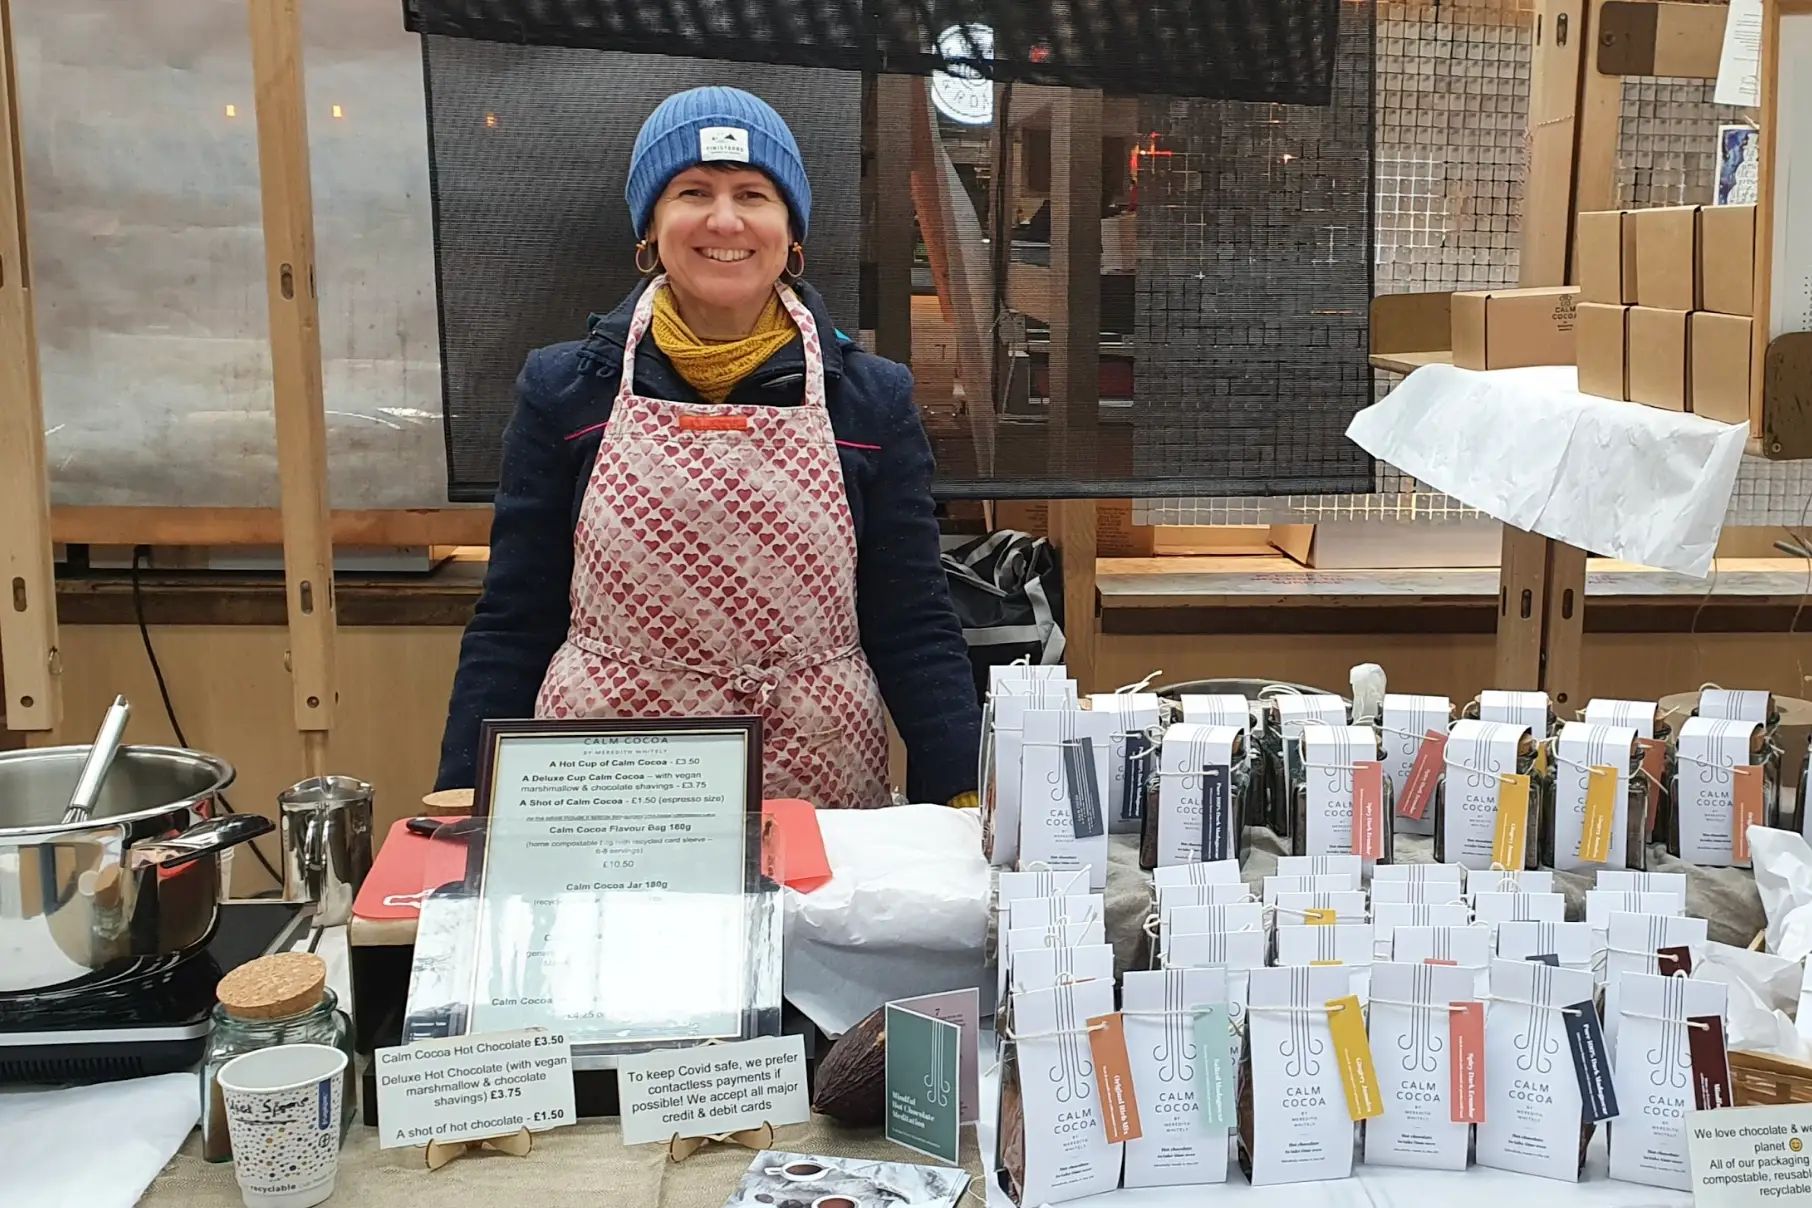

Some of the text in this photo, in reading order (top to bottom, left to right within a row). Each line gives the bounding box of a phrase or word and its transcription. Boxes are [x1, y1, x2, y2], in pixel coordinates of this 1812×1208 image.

[584, 737, 620, 745] CALM
[578, 760, 598, 769] Cup
[567, 774, 586, 783] Cup
[675, 772, 701, 781] vegan
[521, 784, 578, 792] marshmallow
[591, 783, 633, 791] chocolate
[635, 783, 674, 791] shavings
[1466, 795, 1495, 803] CALM
[1700, 790, 1729, 798] CALM
[1180, 797, 1202, 805] CAL
[549, 826, 574, 834] Calm
[577, 825, 607, 833] Cocoa
[648, 824, 666, 833] Bag
[566, 882, 590, 890] Calm
[593, 882, 625, 890] Cocoa
[627, 881, 643, 889] Jar
[492, 997, 553, 1006] Calm Cocoa
[382, 1035, 564, 1064] Calm Cocoa Hot Chocolate £3.50
[382, 1057, 567, 1086] Deluxe Hot Chocolate (with vegan
[628, 1053, 798, 1082] To keep Covid safe, we prefer
[406, 1071, 546, 1096] marshmallow & chocolate
[648, 1069, 781, 1095] contactless payments if
[1401, 1080, 1436, 1090] CALM
[1514, 1080, 1549, 1092] CALM
[1113, 1074, 1124, 1104] Original
[1286, 1086, 1321, 1096] CALM
[434, 1087, 521, 1107] shavings) £3.75
[632, 1083, 798, 1114] possible! We accept all major
[1160, 1092, 1194, 1101] CALM
[1396, 1091, 1440, 1102] COCOA
[1508, 1090, 1553, 1104] COCOA
[1649, 1096, 1685, 1107] CALM
[892, 1101, 903, 1110] Hot
[1155, 1103, 1199, 1113] COCOA
[1282, 1098, 1326, 1108] COCOA
[662, 1100, 772, 1123] credit & debit cards
[1058, 1108, 1092, 1122] CALM
[396, 1109, 564, 1139] A shot of hot chocolate £1.50
[1054, 1119, 1097, 1134] COCOA
[1694, 1129, 1712, 1138] We
[1715, 1128, 1736, 1138] love
[1739, 1126, 1787, 1136] chocolate
[1791, 1124, 1798, 1133] &
[1754, 1141, 1786, 1154] planet
[1710, 1155, 1809, 1169] All of our packaging
[1703, 1169, 1812, 1185] compostable, reusabl
[250, 1184, 296, 1193] recyclable
[1760, 1184, 1811, 1197] recyclable
